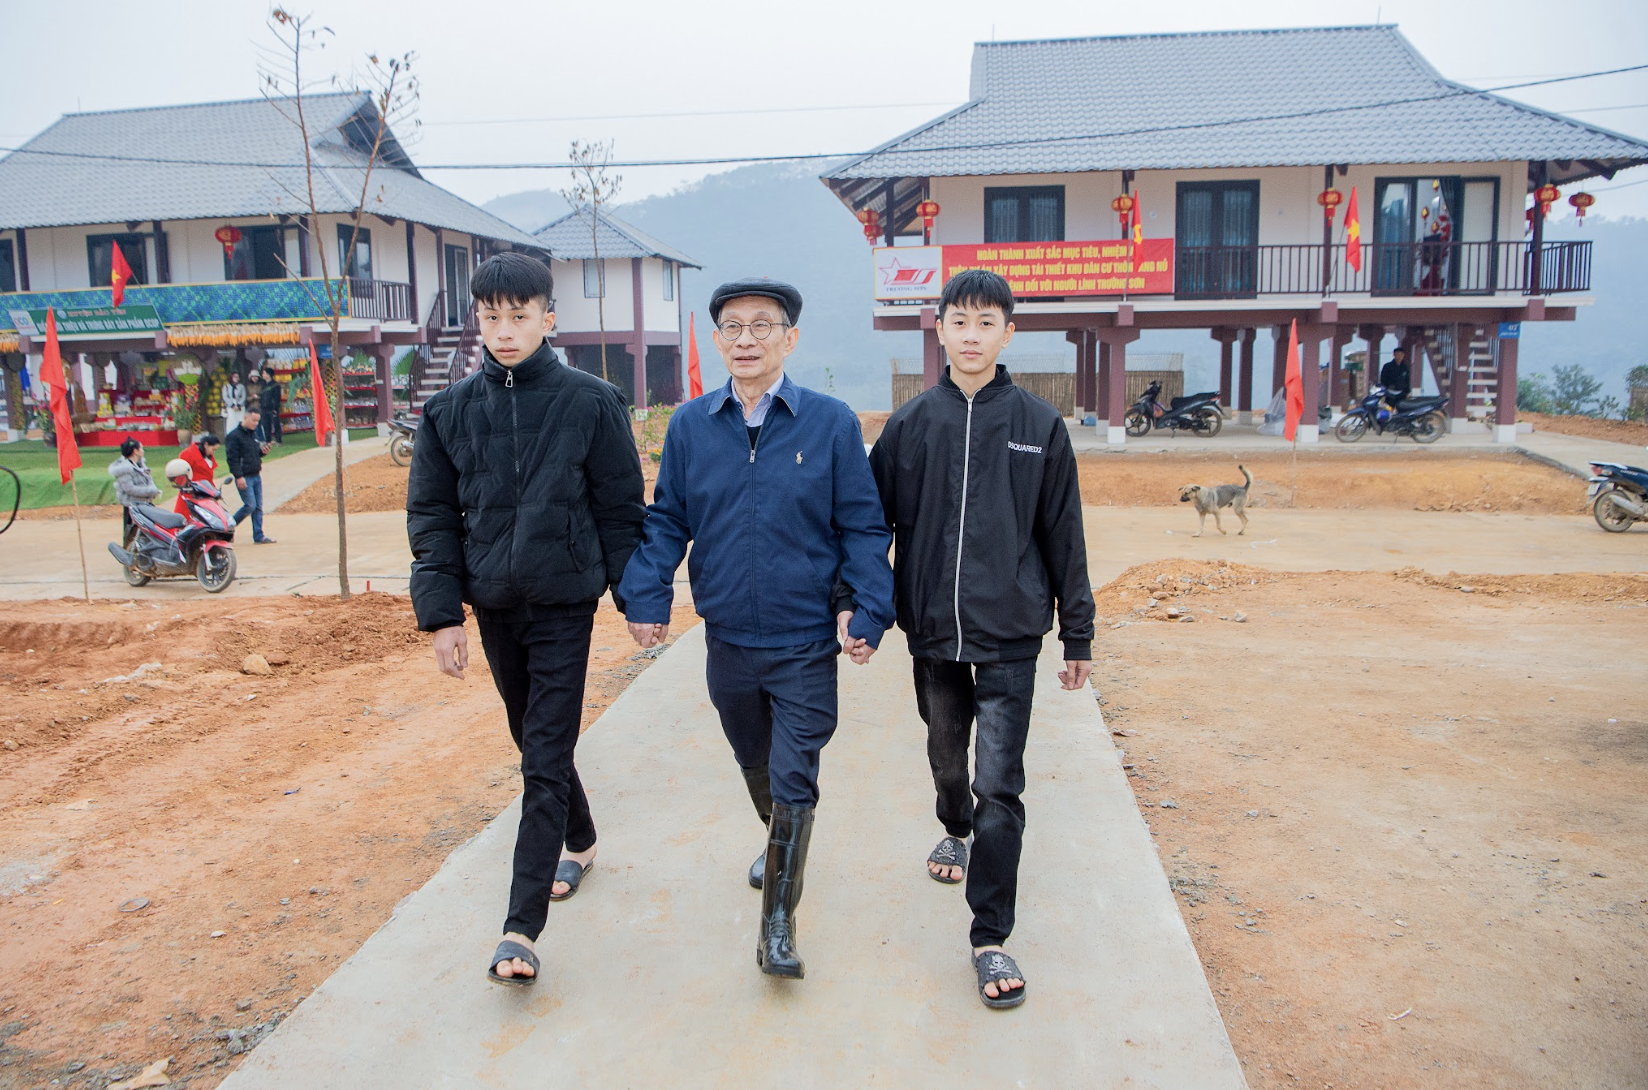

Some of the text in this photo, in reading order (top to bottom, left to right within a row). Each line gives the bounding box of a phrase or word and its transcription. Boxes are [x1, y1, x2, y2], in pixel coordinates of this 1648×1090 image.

[977, 248, 998, 260] HOÀN
[999, 247, 1024, 260] THÀNH
[1025, 246, 1045, 260] XUẤT
[1046, 245, 1061, 259] SẮC
[1063, 247, 1080, 260] MỤC
[1082, 245, 1101, 259] TIÊU,
[1102, 244, 1127, 259] NHIỆM
[1045, 261, 1066, 275] THIẾT
[1066, 263, 1083, 275] KHU
[1083, 261, 1100, 274] DÂN
[1053, 277, 1077, 291] NGƯỜI
[1078, 277, 1096, 290] LÍNH
[1128, 277, 1145, 289] SƠN
[1007, 440, 1043, 454] DSQUARED2
